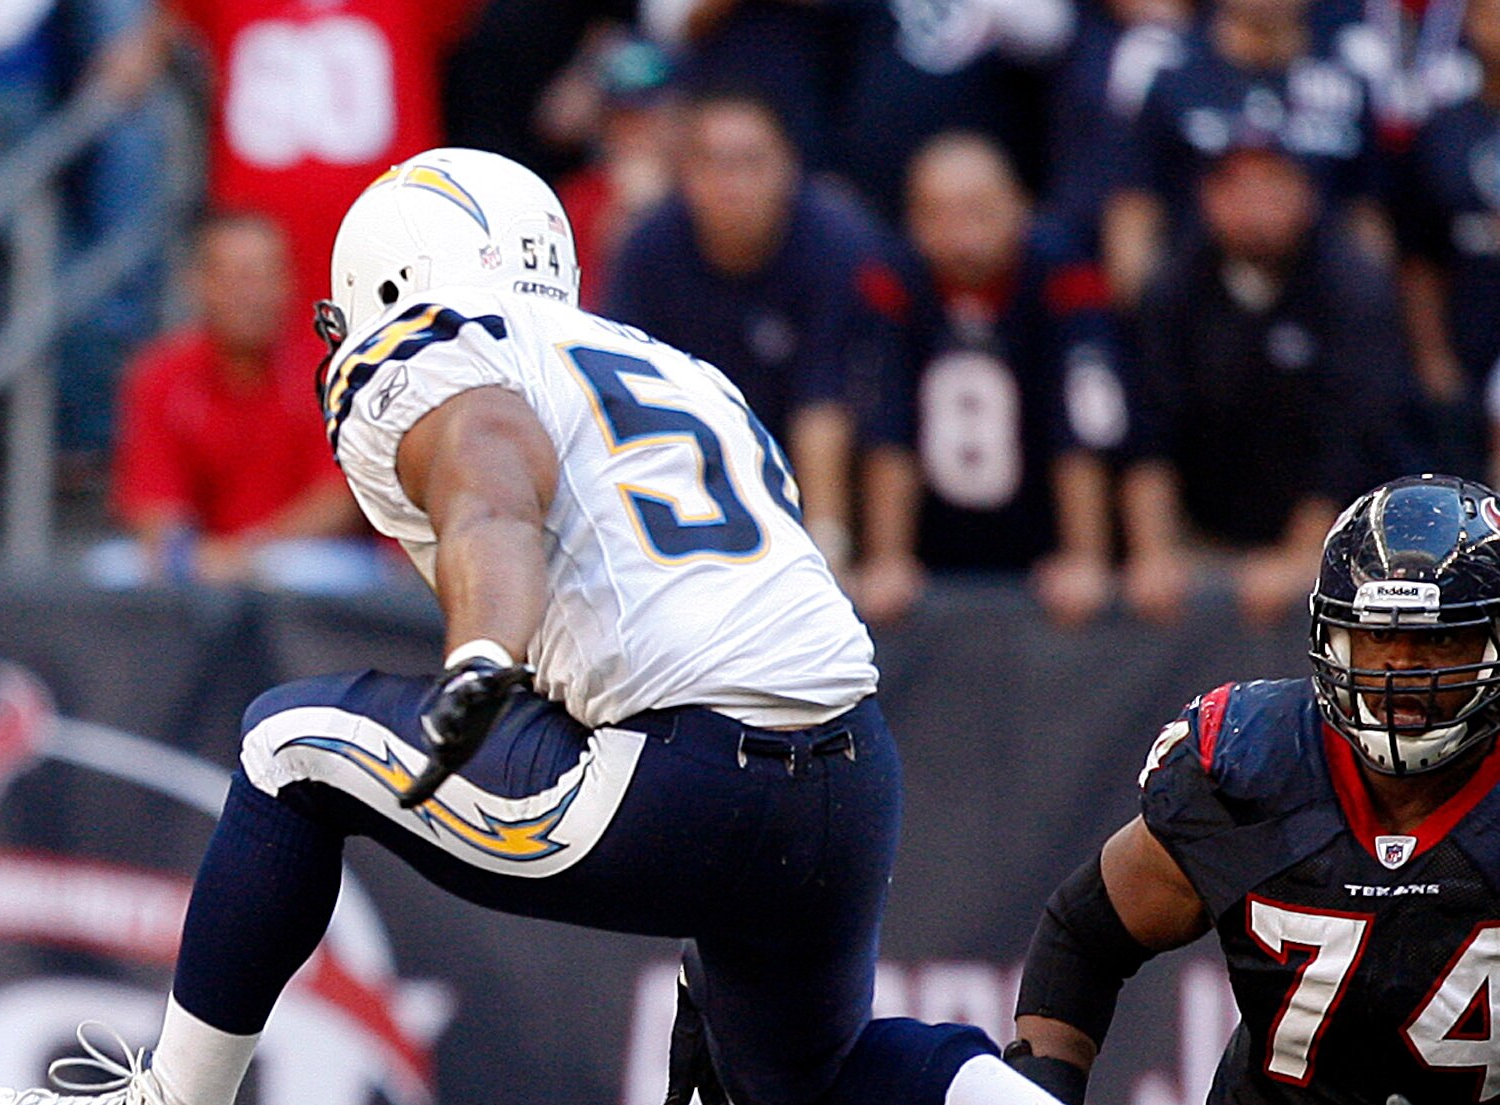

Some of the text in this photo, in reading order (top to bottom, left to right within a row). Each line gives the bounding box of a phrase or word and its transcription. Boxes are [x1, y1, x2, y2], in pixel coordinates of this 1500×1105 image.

[520, 237, 560, 278] 54
[1344, 883, 1440, 897] TEXANS
[1245, 891, 1500, 1105] 74
